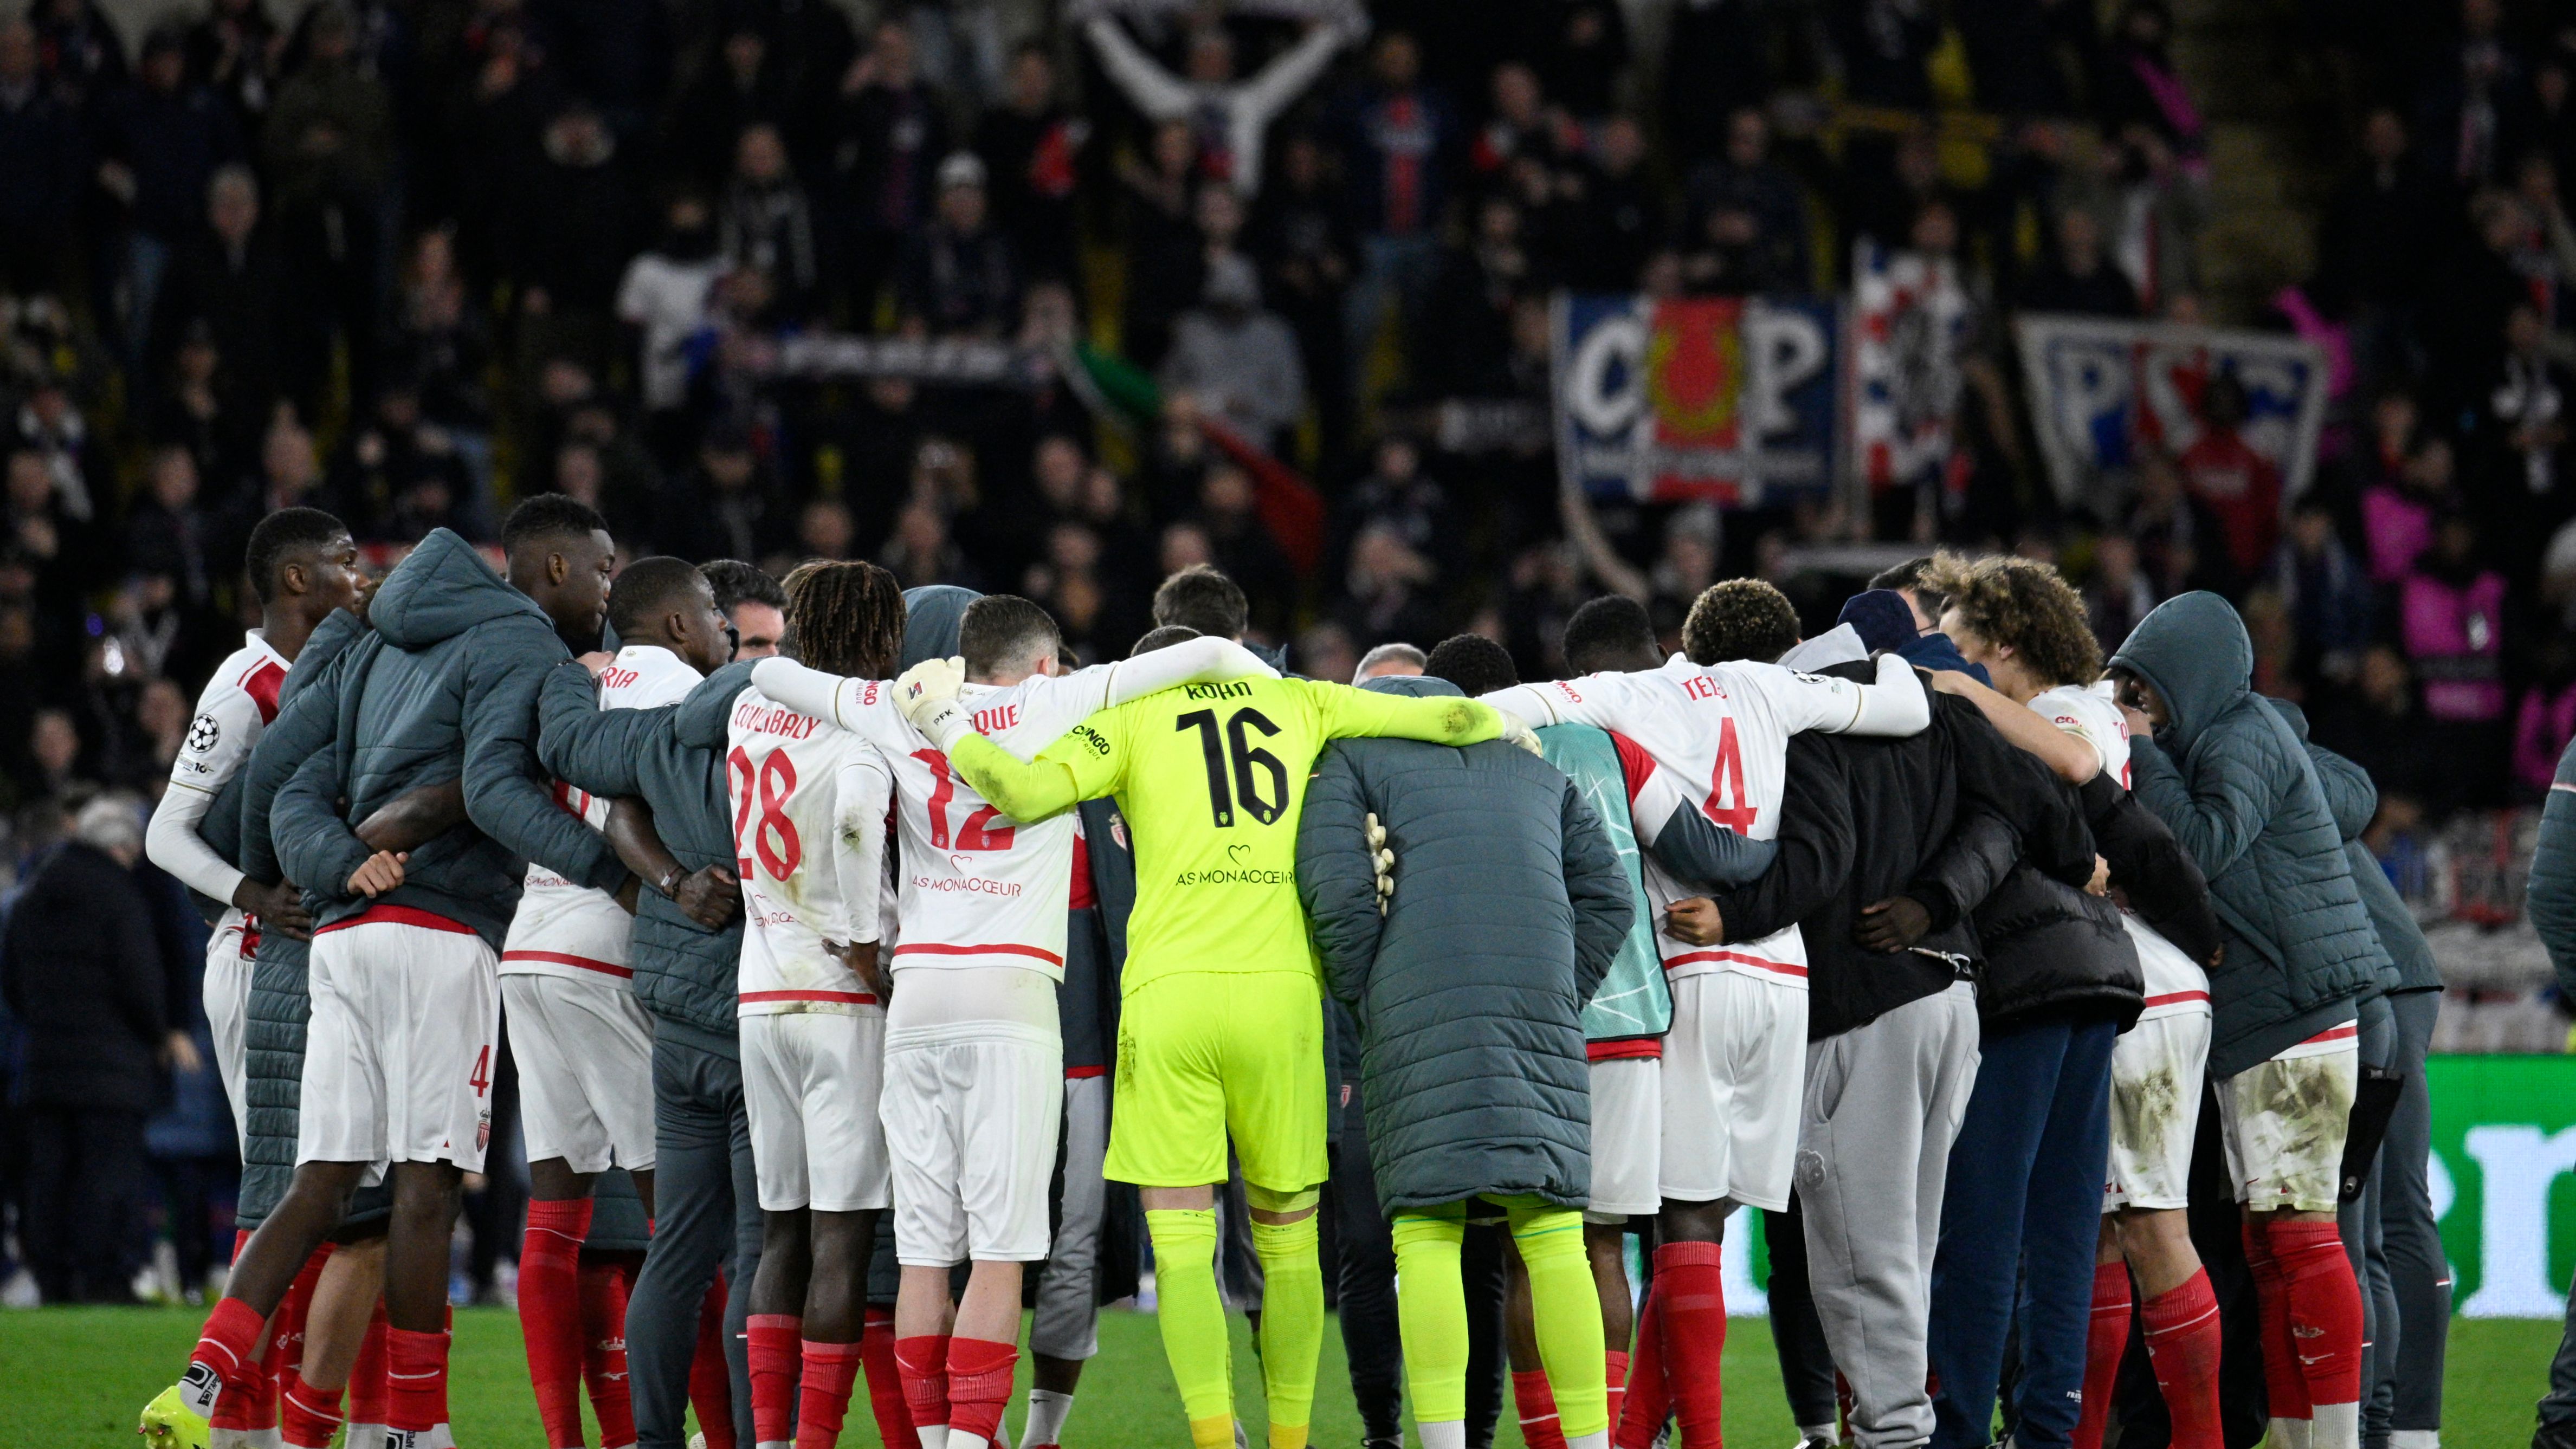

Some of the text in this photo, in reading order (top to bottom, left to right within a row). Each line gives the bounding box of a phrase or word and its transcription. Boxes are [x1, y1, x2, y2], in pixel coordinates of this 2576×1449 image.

[602, 667, 638, 688] RIA
[1681, 675, 1727, 701] TE
[1555, 681, 1581, 703] NGO
[933, 709, 954, 726] PFK
[970, 704, 1019, 736] QUE
[1176, 707, 1289, 827] 16
[1702, 717, 1758, 836] 4
[909, 748, 1015, 851] 12
[726, 745, 801, 882] 28
[913, 875, 929, 887] AS
[1176, 874, 1196, 885] AS
